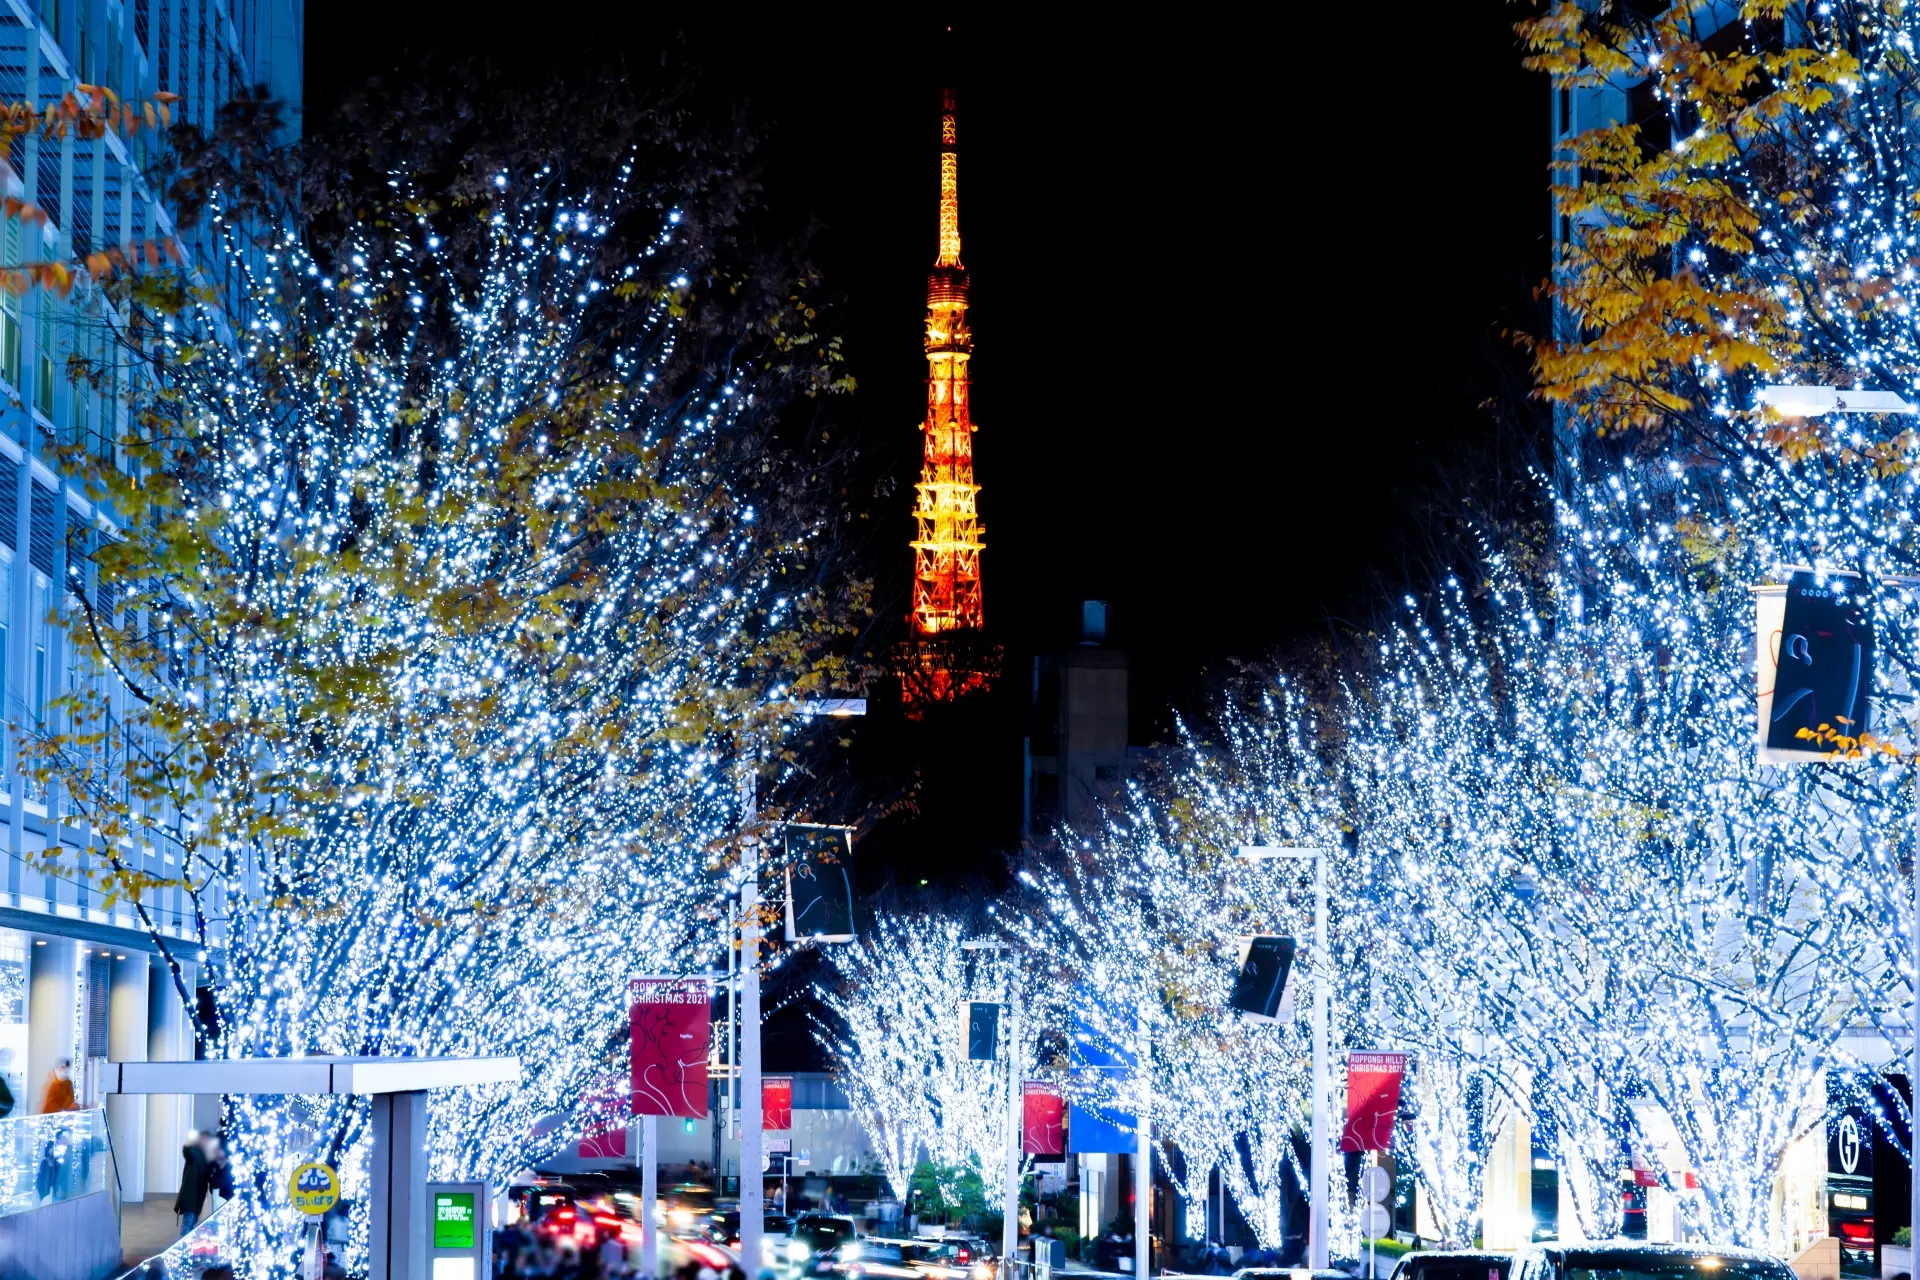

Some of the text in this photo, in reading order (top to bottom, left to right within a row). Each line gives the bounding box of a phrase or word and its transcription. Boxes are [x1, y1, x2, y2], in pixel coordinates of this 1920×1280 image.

[632, 993, 707, 1004] CHRISTMAS 2021
[1350, 1055, 1404, 1064] ROPPONGI HILLS
[1350, 1064, 1403, 1073] CHRISTMAS 2021
